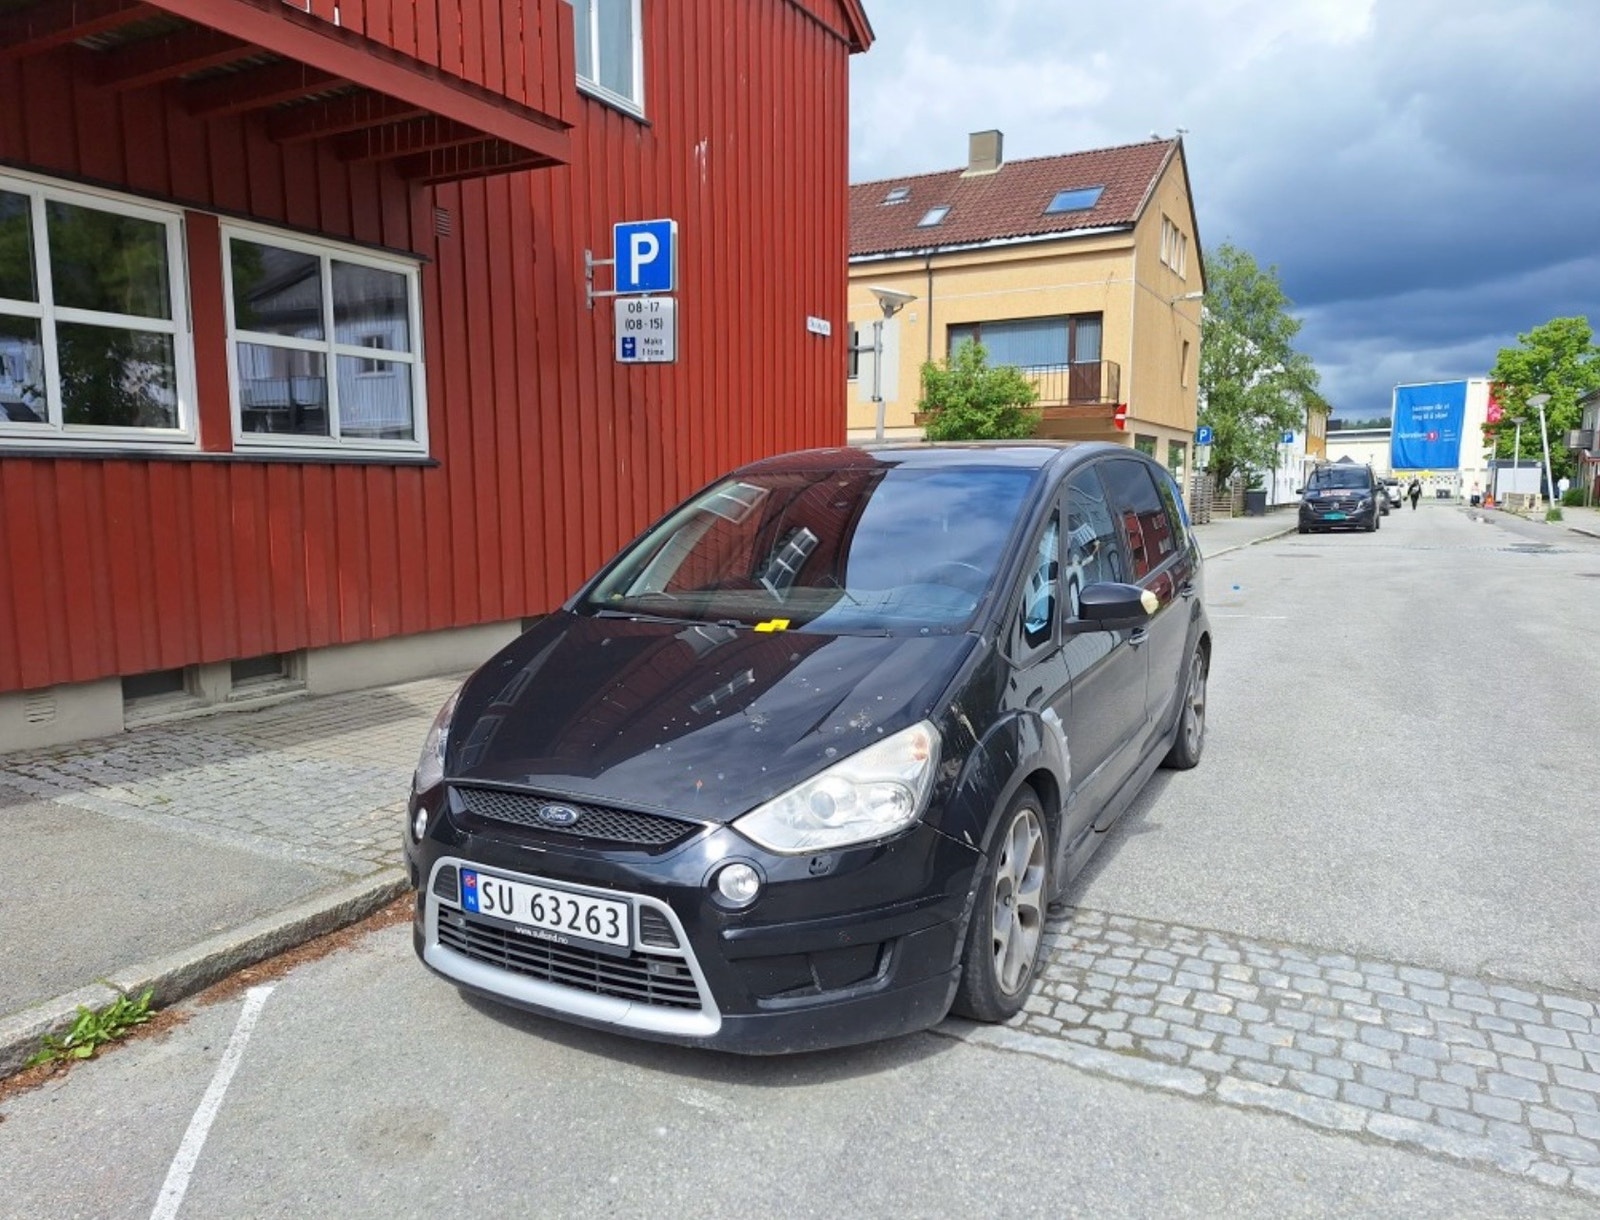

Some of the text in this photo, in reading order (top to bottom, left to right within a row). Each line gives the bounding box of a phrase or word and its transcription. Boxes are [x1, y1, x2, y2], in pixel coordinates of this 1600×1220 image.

[630, 232, 660, 285] P
[1200, 429, 1208, 441] P
[482, 881, 621, 939] SU 63263
